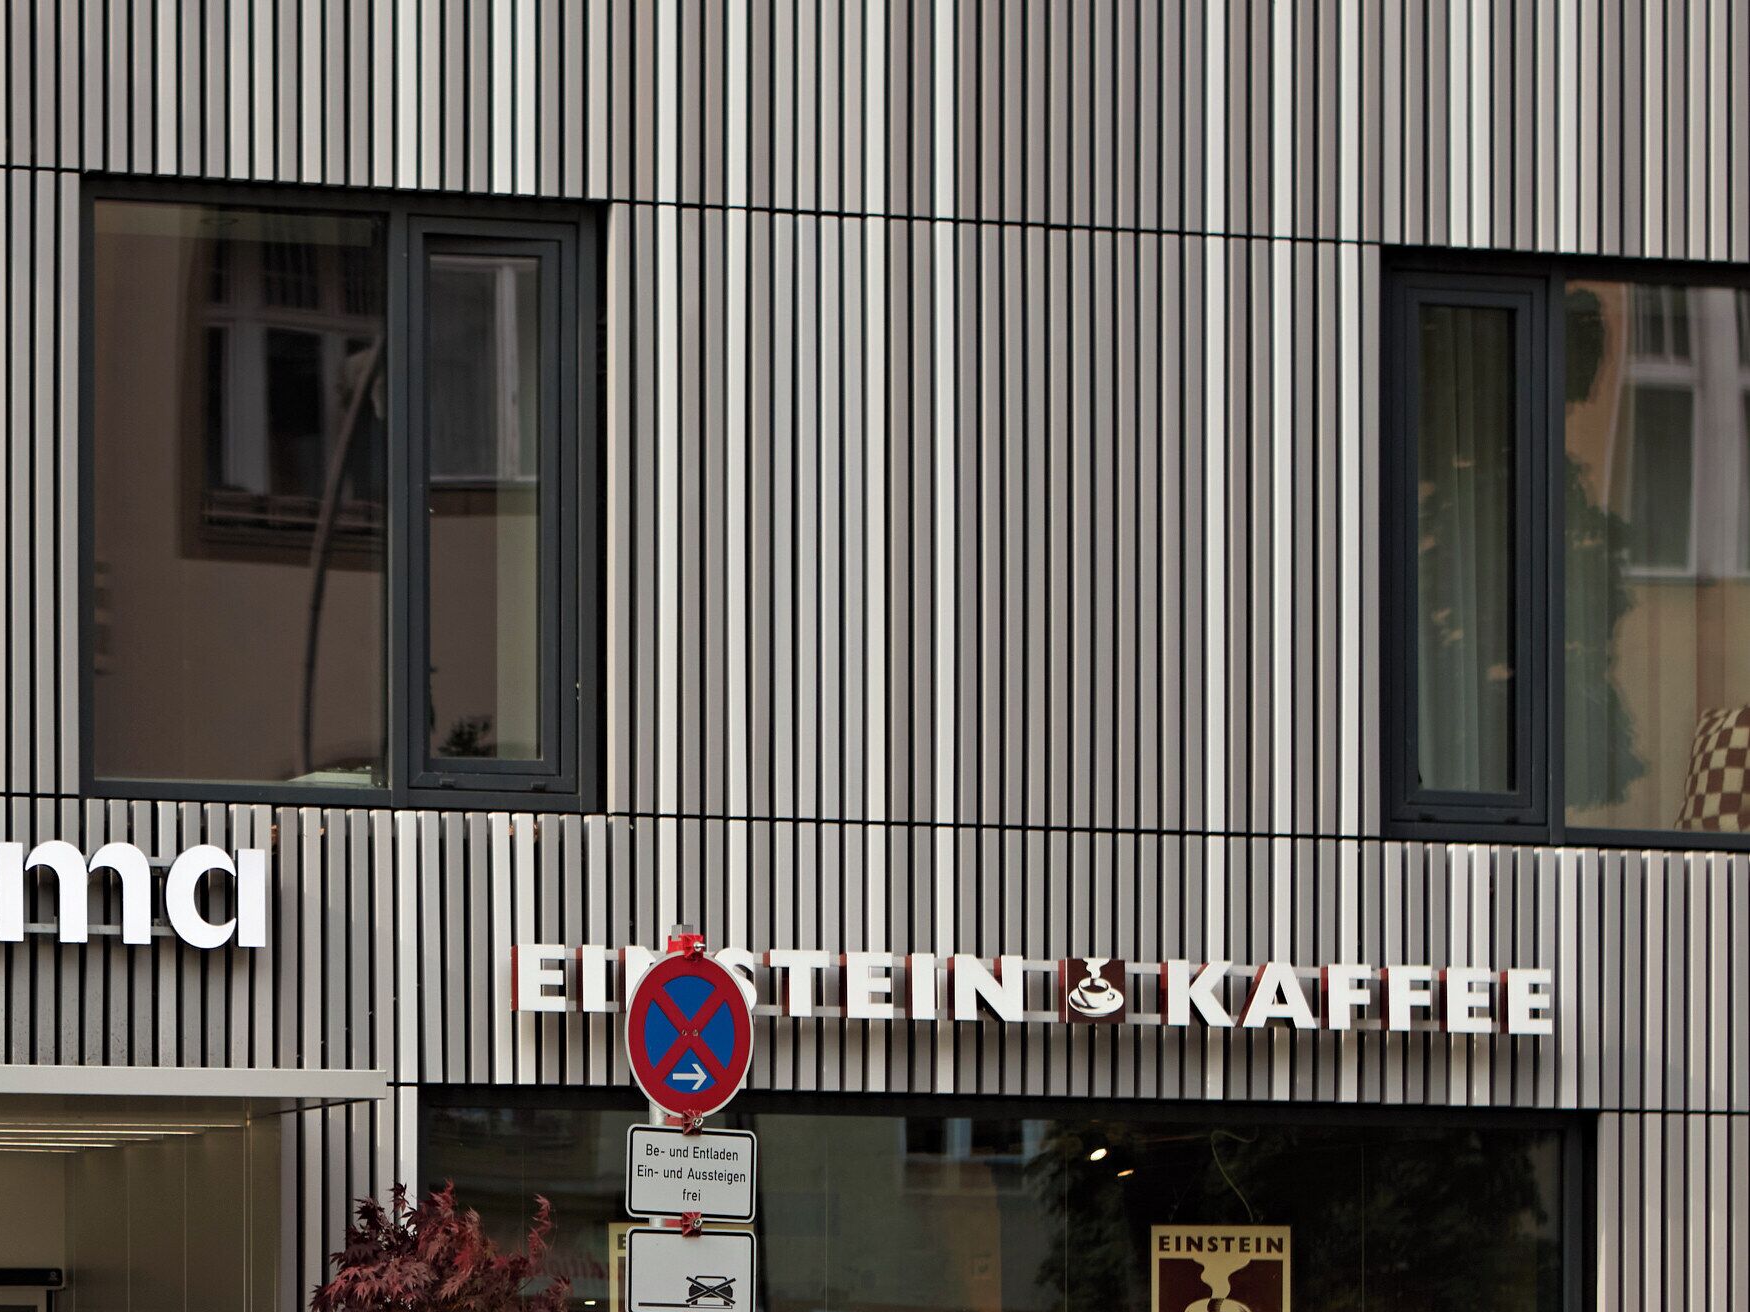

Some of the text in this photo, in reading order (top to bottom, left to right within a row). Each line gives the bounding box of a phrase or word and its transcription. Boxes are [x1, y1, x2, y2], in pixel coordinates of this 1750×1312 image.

[1163, 959, 1553, 1036] KAFFEE
[645, 1143, 739, 1161] Be- und Entladen
[637, 1164, 746, 1185] Ein- und Aussteigen
[682, 1188, 701, 1202] frei
[1158, 1235, 1284, 1254] EINSTEIN
